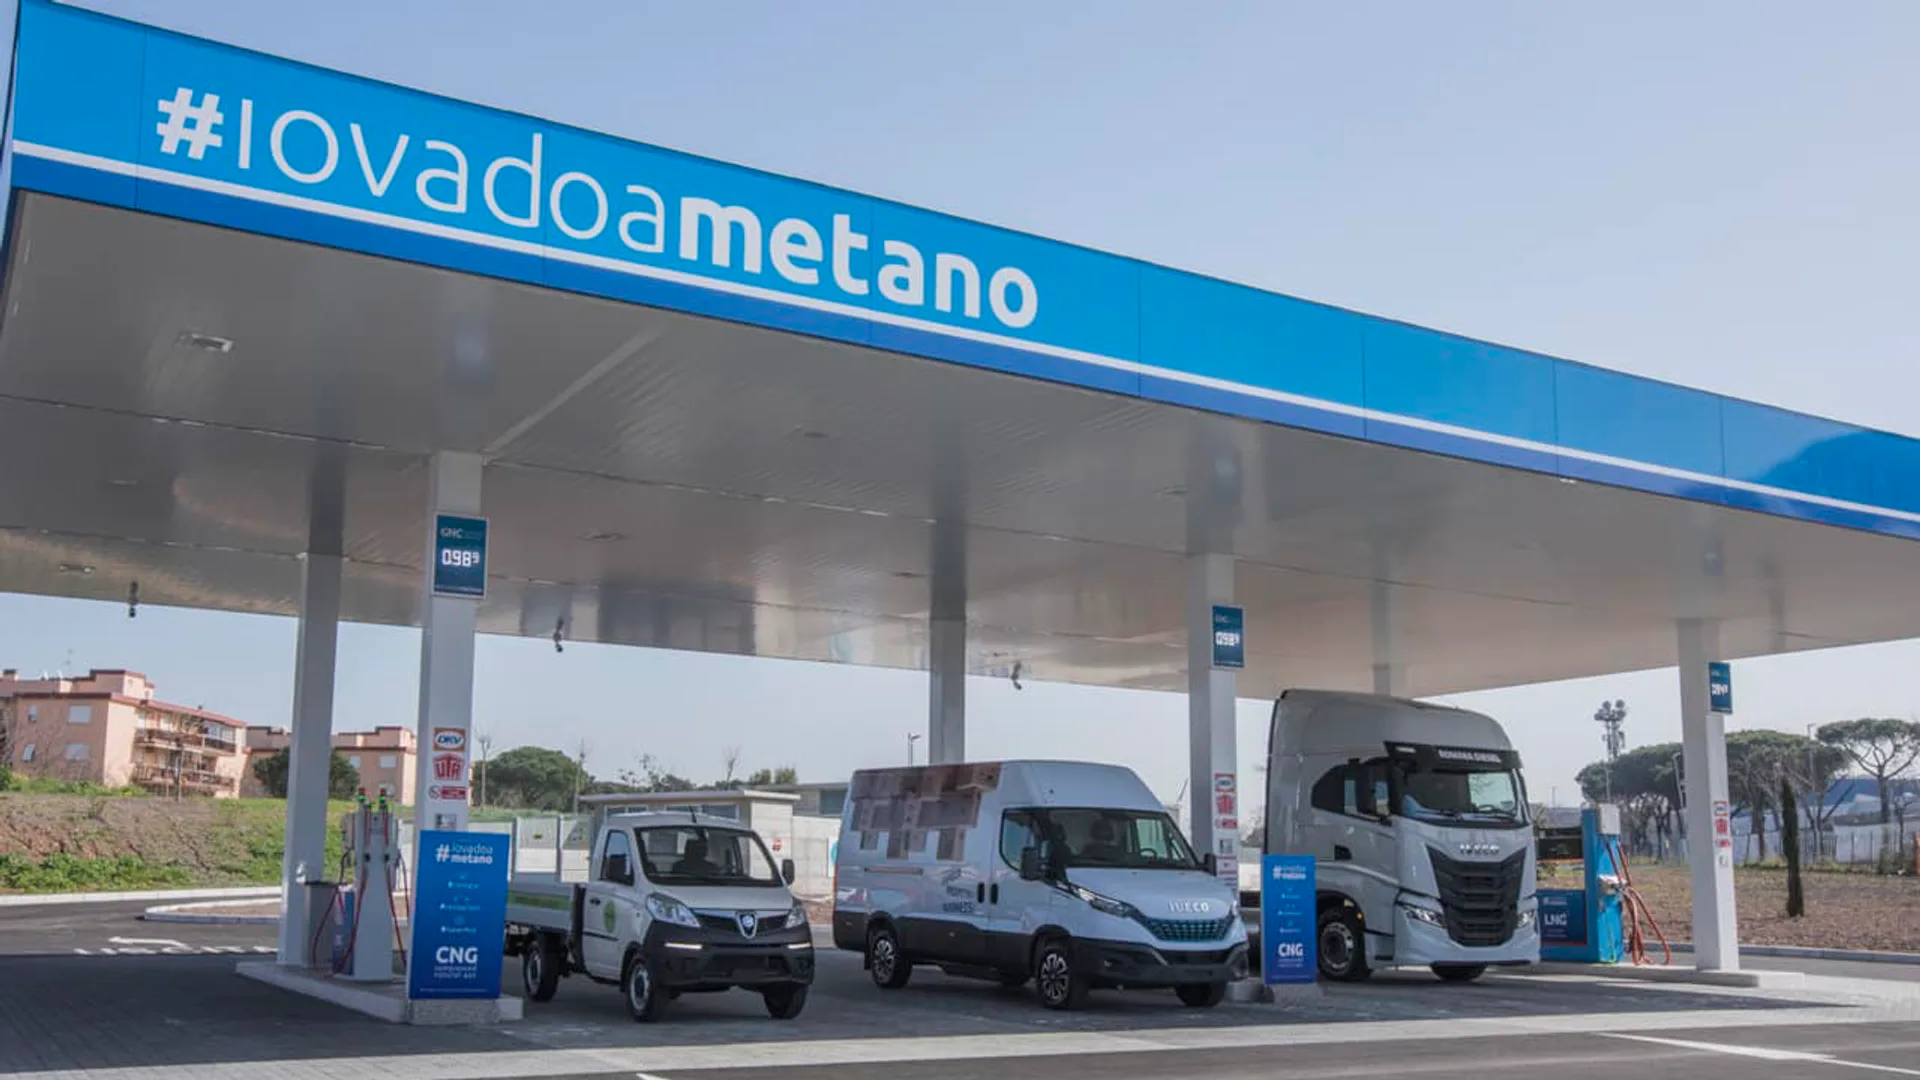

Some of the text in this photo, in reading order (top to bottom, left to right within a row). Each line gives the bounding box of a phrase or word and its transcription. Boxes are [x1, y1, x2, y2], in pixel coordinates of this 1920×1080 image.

[1168, 900, 1210, 913] IVECO
[436, 947, 478, 964] CNG
[1278, 943, 1304, 957] CNG
